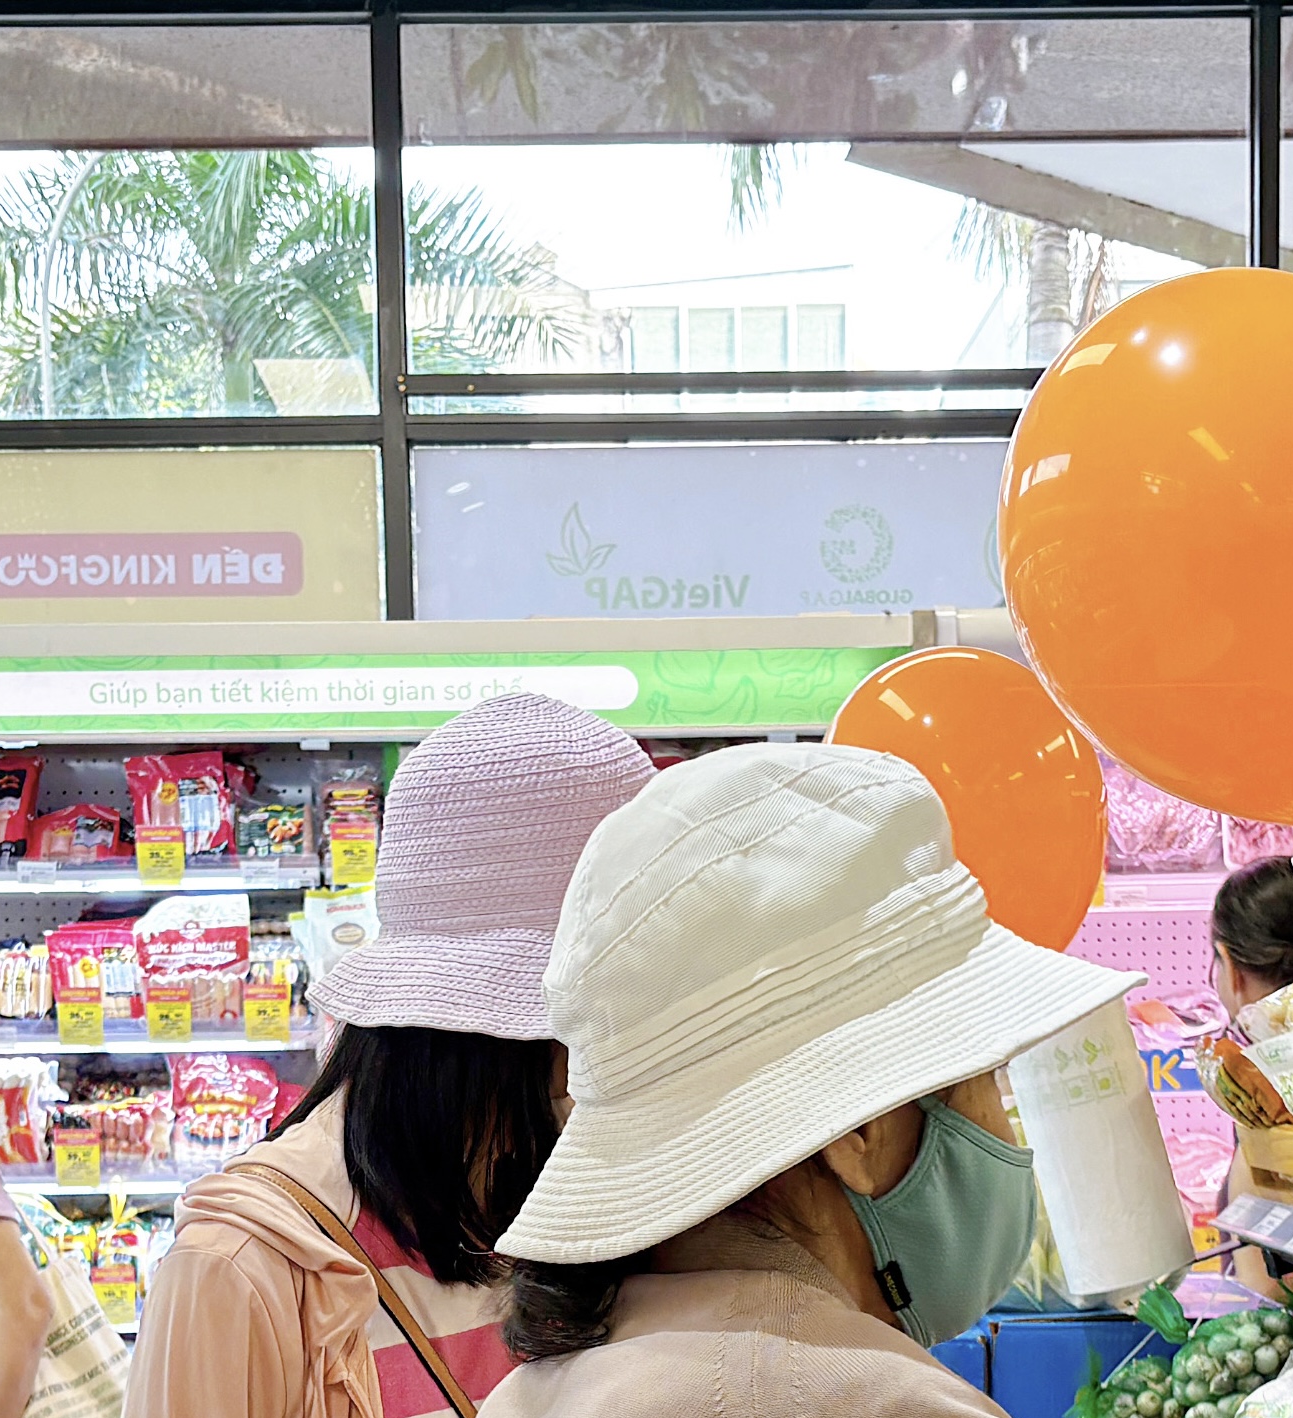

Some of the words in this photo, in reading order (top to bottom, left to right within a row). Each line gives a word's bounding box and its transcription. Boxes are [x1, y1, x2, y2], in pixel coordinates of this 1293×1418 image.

[89, 680, 148, 709] Giúp
[155, 682, 203, 710] bạn
[210, 676, 256, 703] tiết
[260, 679, 319, 707] kiệm
[326, 676, 376, 702] thời
[382, 680, 438, 709] gian
[443, 681, 472, 702] sơ
